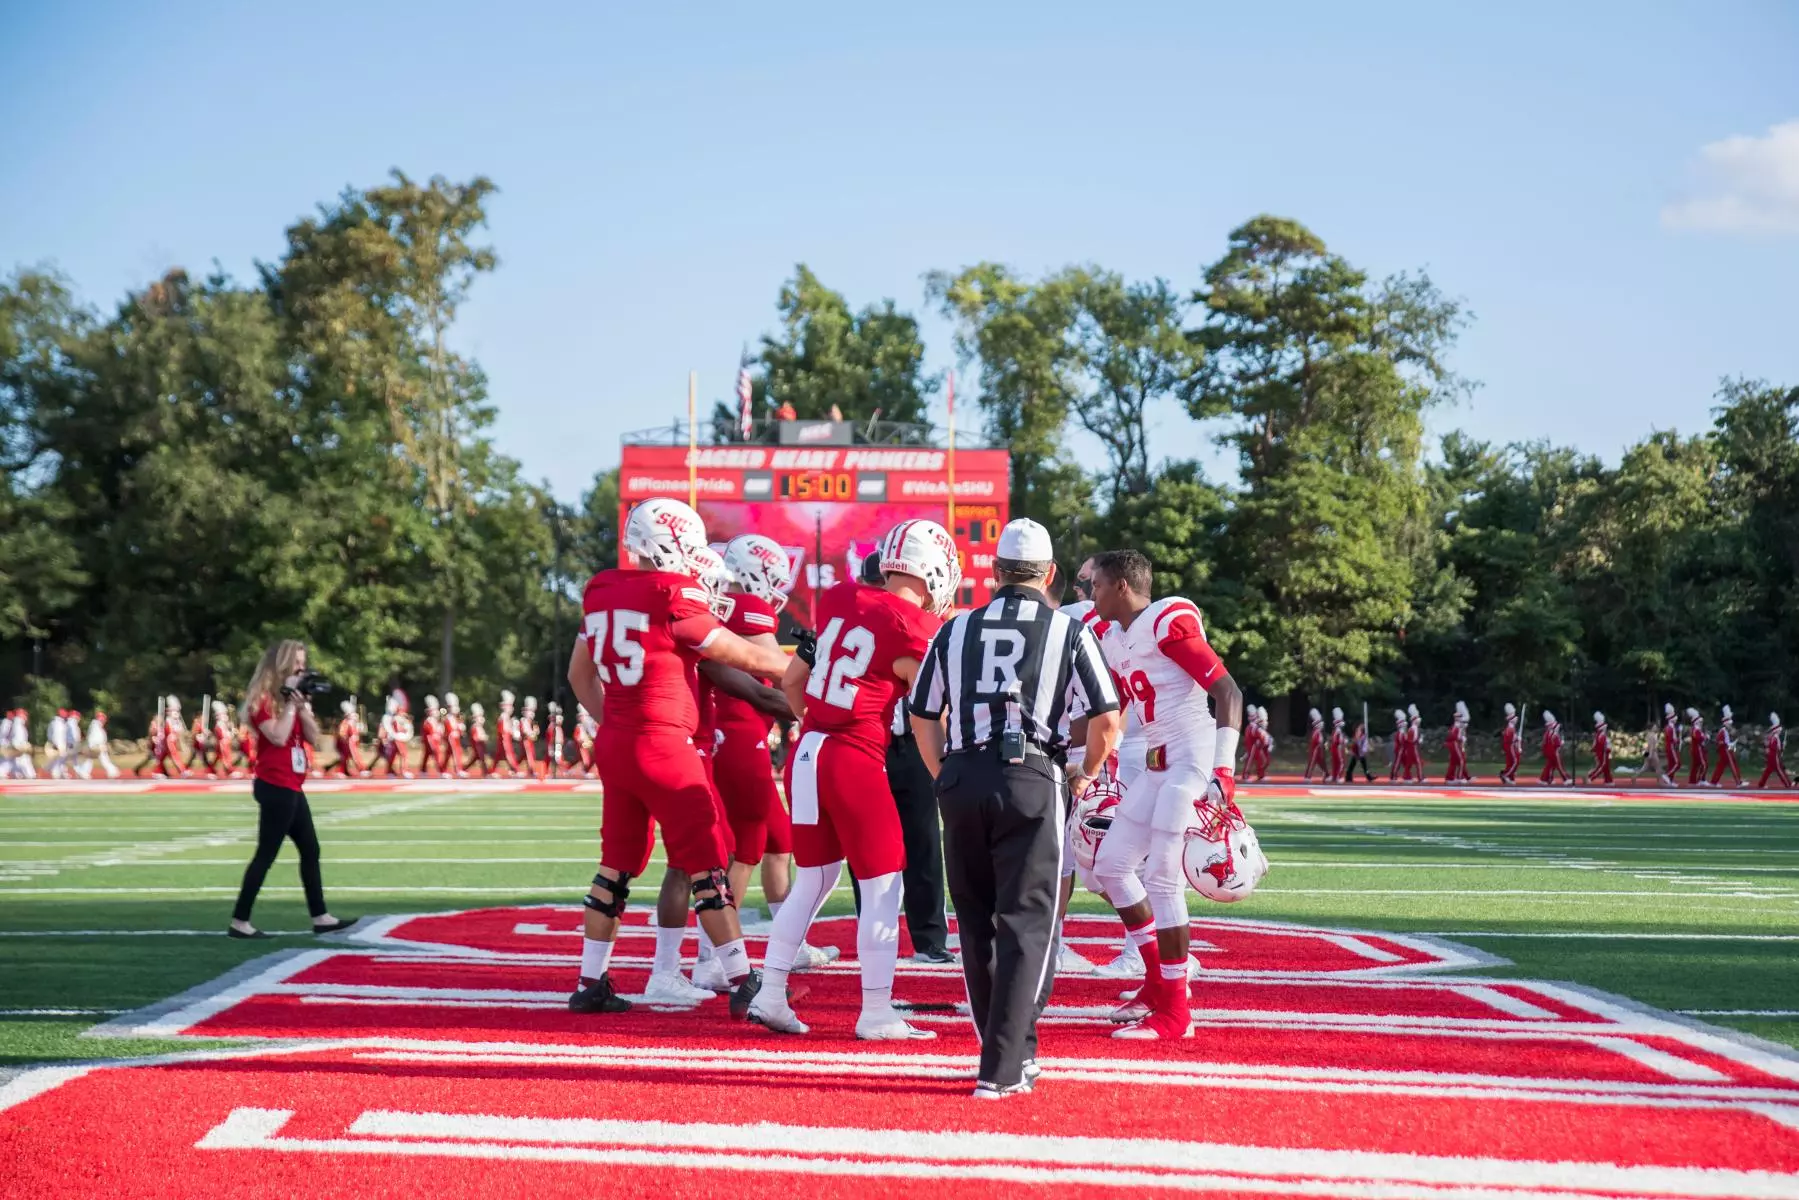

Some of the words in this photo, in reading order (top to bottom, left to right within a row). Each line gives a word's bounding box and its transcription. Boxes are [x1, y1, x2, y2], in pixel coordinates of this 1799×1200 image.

[685, 449, 767, 469] SACRED
[770, 450, 839, 470] HEART
[843, 451, 946, 471] PIONEERS
[628, 476, 735, 493] #PioneePride
[787, 473, 852, 500] 15:00
[902, 480, 994, 496] #WeAeSHU
[985, 519, 1001, 544] 0
[584, 609, 649, 686] 75
[976, 628, 1026, 694] R
